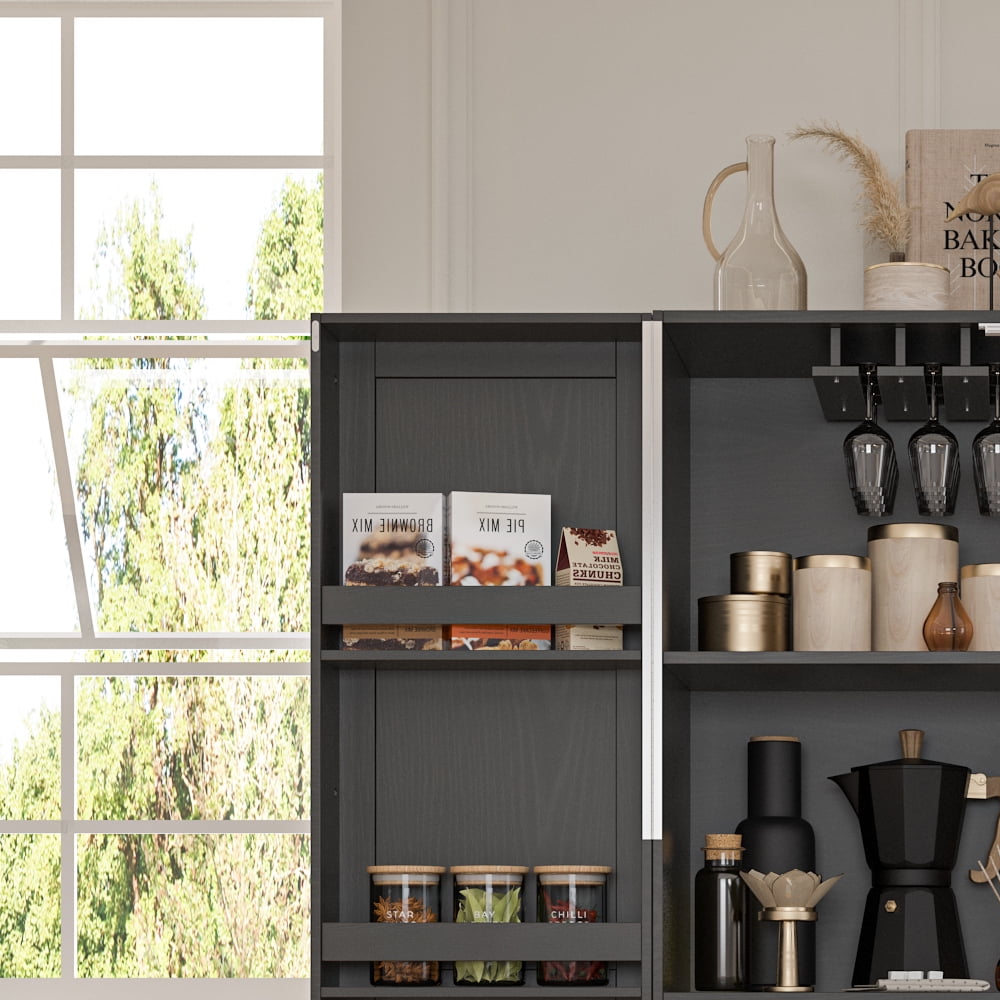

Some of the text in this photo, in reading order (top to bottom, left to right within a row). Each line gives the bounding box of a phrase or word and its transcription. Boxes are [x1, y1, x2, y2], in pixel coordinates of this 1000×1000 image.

[386, 910, 414, 919] STAR
[473, 910, 495, 919] BAY
[551, 910, 587, 919] CHILLI
